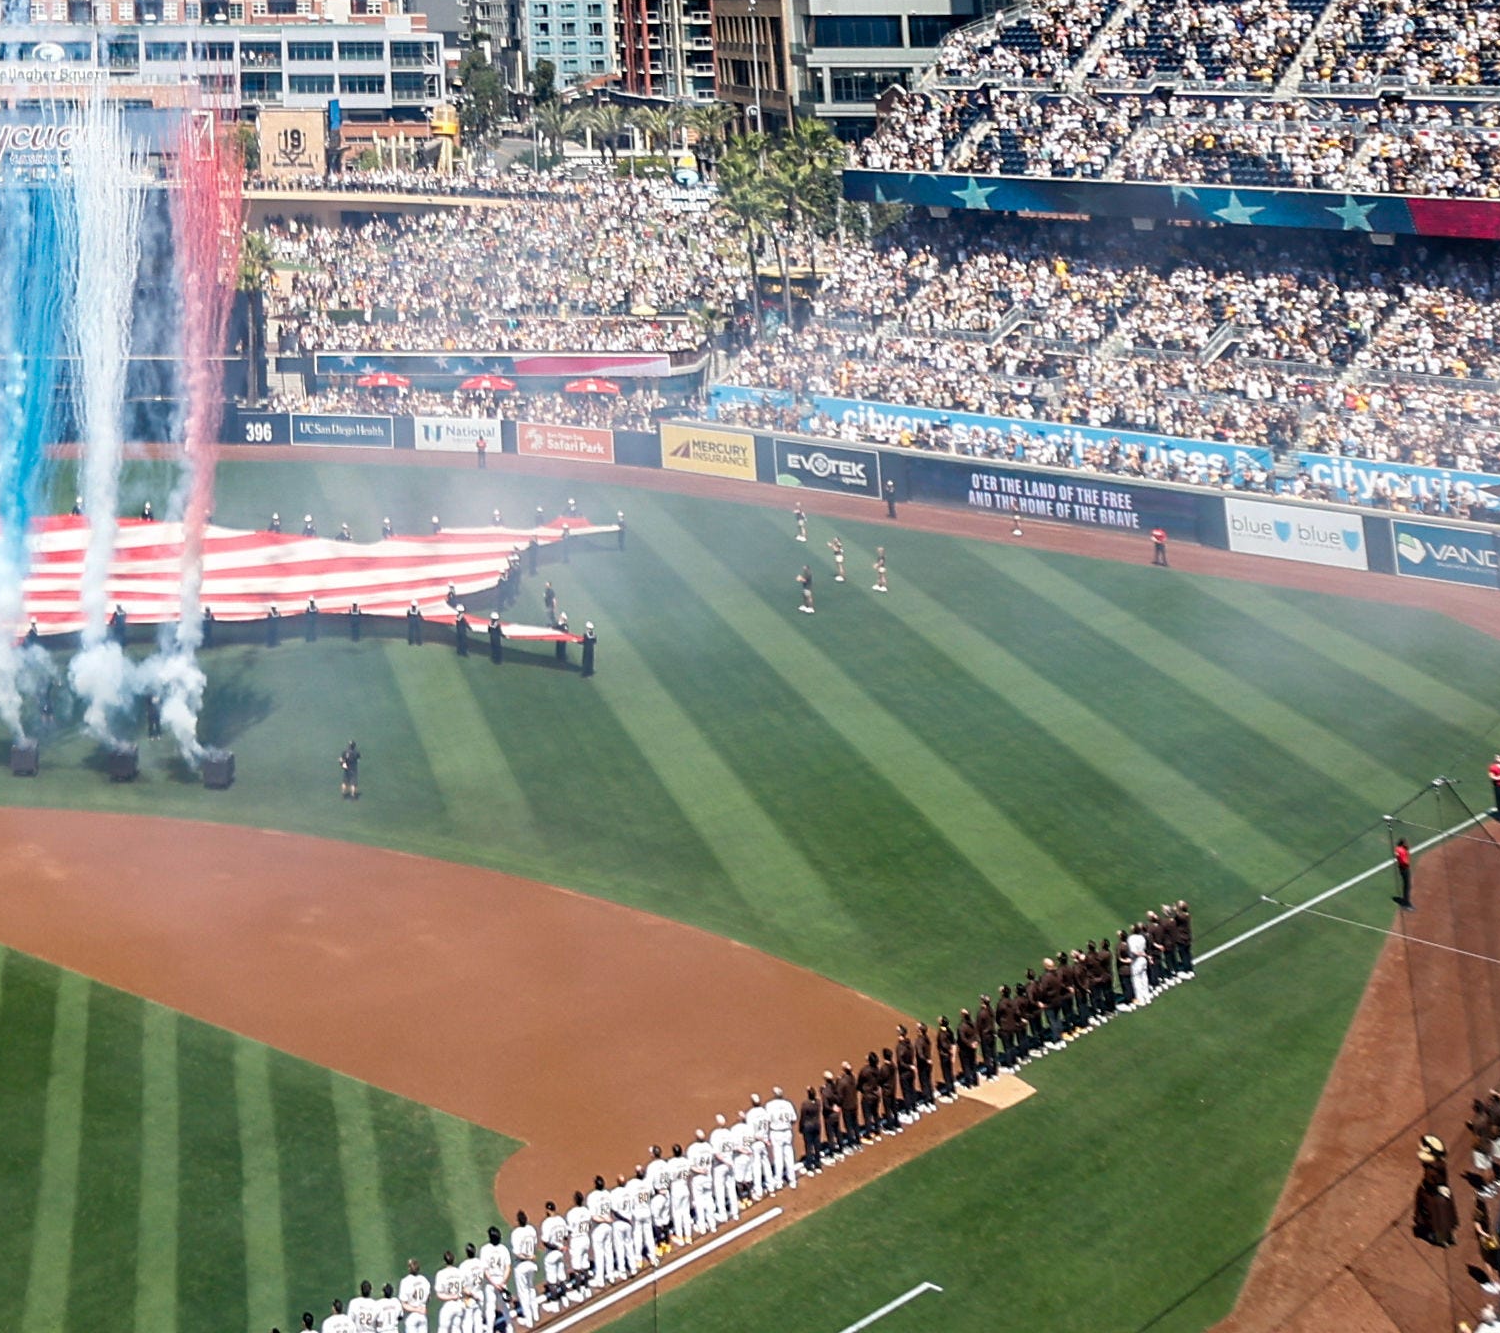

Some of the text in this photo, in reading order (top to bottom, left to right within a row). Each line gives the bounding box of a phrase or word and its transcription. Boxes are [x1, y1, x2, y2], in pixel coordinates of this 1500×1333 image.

[284, 129, 302, 150] 19
[246, 423, 272, 442] 396
[300, 422, 385, 438] UC San Diego Health
[446, 425, 495, 438] National
[547, 438, 605, 454] Safari Park
[692, 438, 747, 456] MERCURY
[692, 450, 749, 468] INSURANCE
[787, 452, 866, 478] EVOTEK
[971, 472, 1133, 510] O'ER THE LAND OF THE FREE
[968, 489, 992, 507] AND
[1020, 498, 1053, 517] HOME
[1056, 502, 1071, 519] OF
[1073, 504, 1097, 523] THE
[1099, 508, 1140, 530] BRAVE
[1231, 515, 1273, 536] blue
[1297, 523, 1342, 545] blue
[359, 1311, 373, 1326] 22
